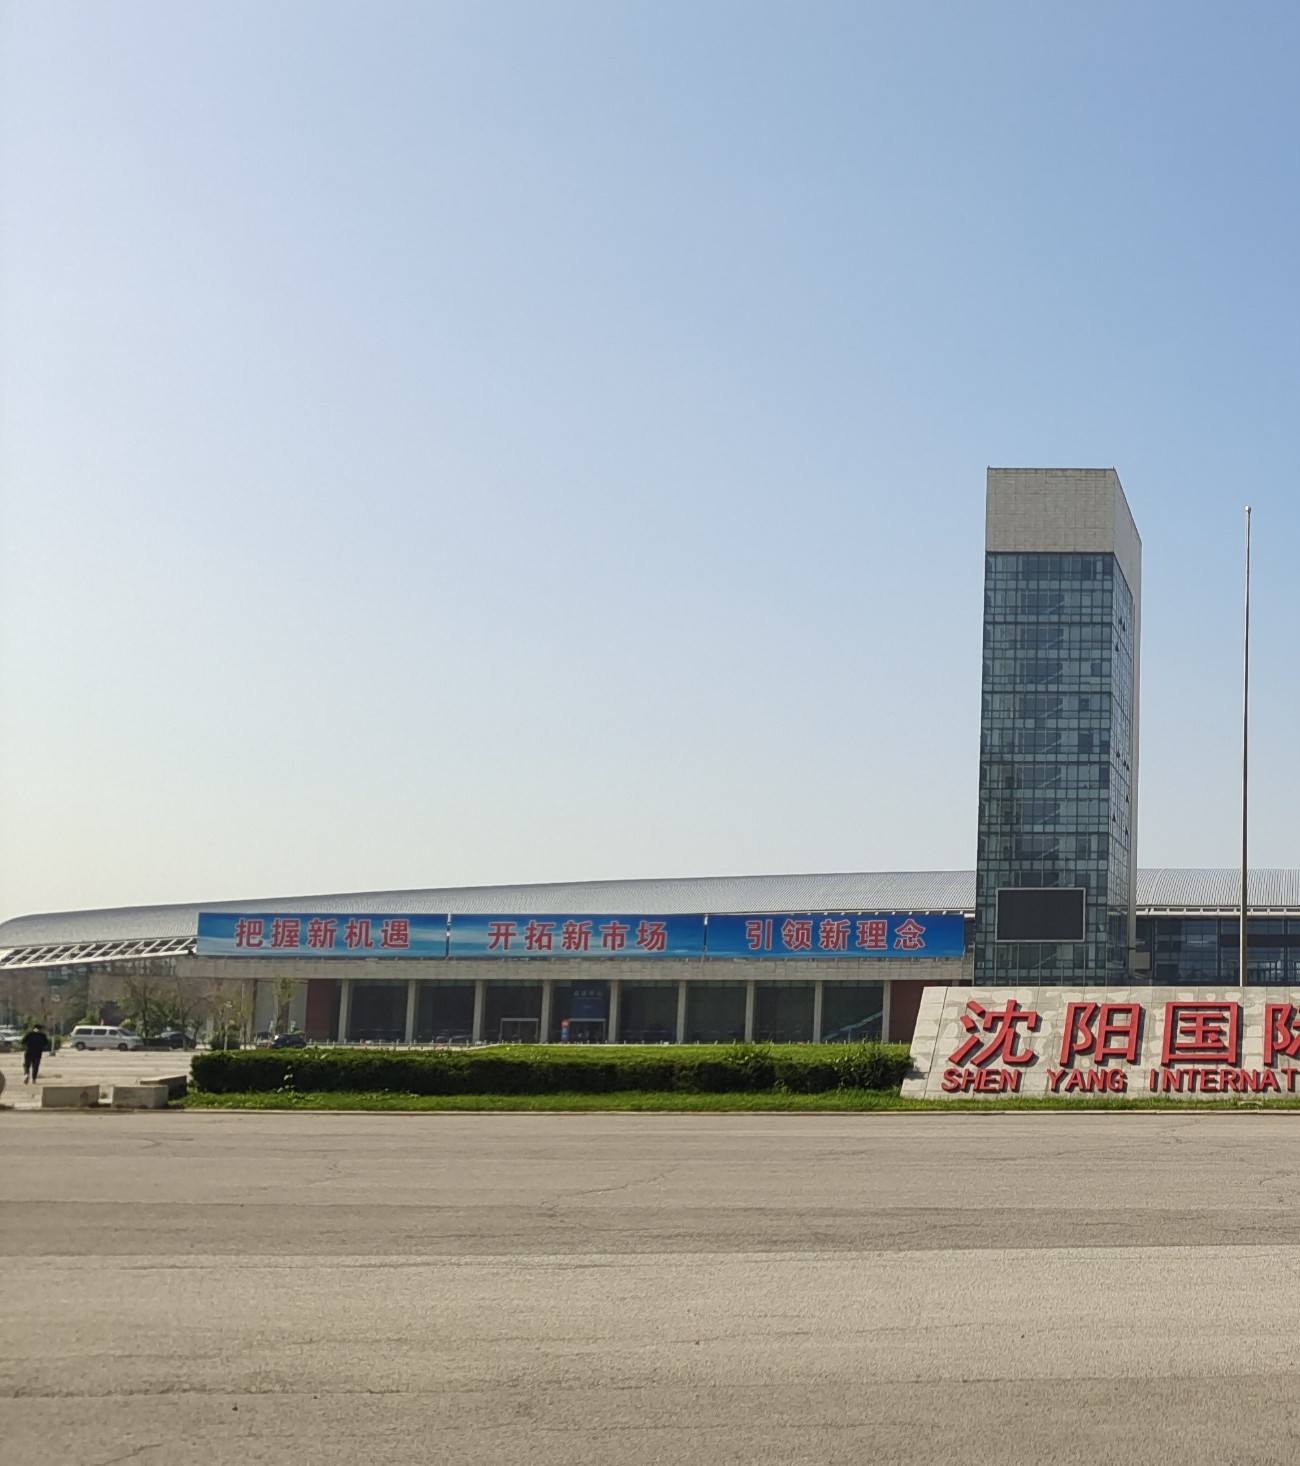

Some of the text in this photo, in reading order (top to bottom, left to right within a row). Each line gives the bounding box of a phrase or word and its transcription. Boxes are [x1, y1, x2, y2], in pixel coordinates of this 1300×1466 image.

[235, 917, 410, 949] 把握新机遇
[487, 919, 668, 952] 开拓新市场
[745, 917, 926, 951] 引领新理念
[941, 1067, 1021, 1092] SHEN
[1047, 1067, 1127, 1092] YANG
